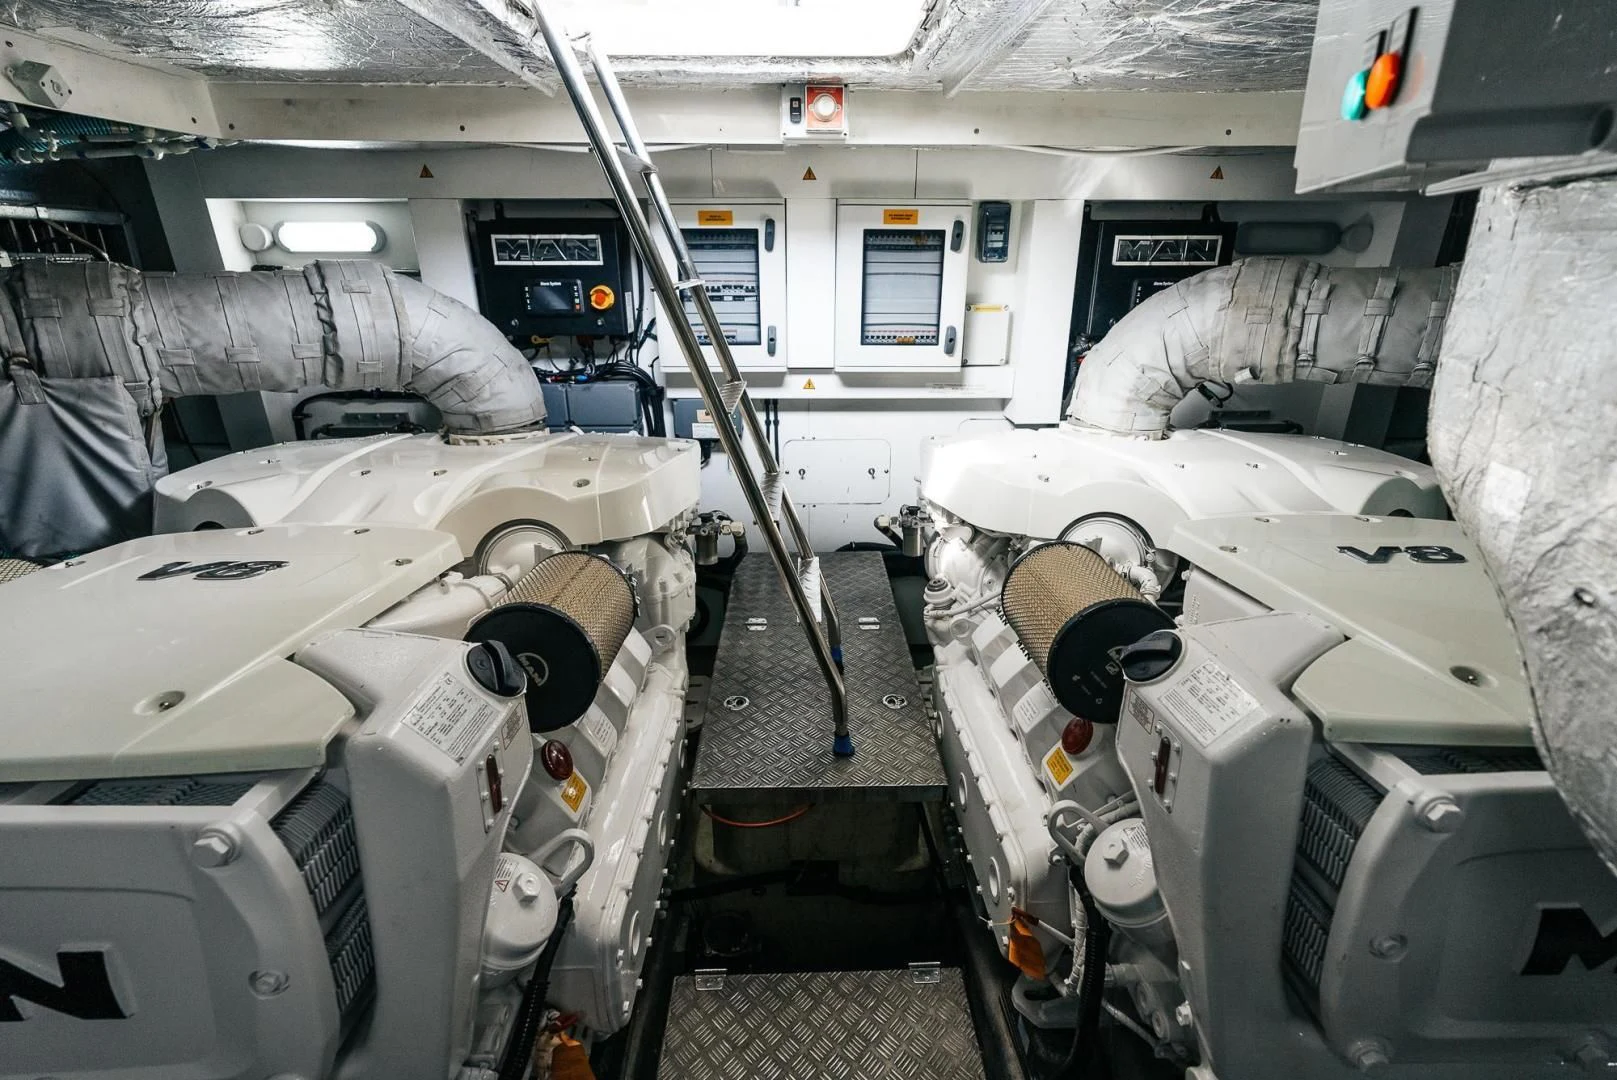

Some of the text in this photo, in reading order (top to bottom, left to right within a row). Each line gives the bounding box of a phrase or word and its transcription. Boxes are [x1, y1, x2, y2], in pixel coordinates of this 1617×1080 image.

[493, 237, 601, 262] MAN
[1115, 237, 1220, 263] MAN
[1335, 545, 1468, 564] V8
